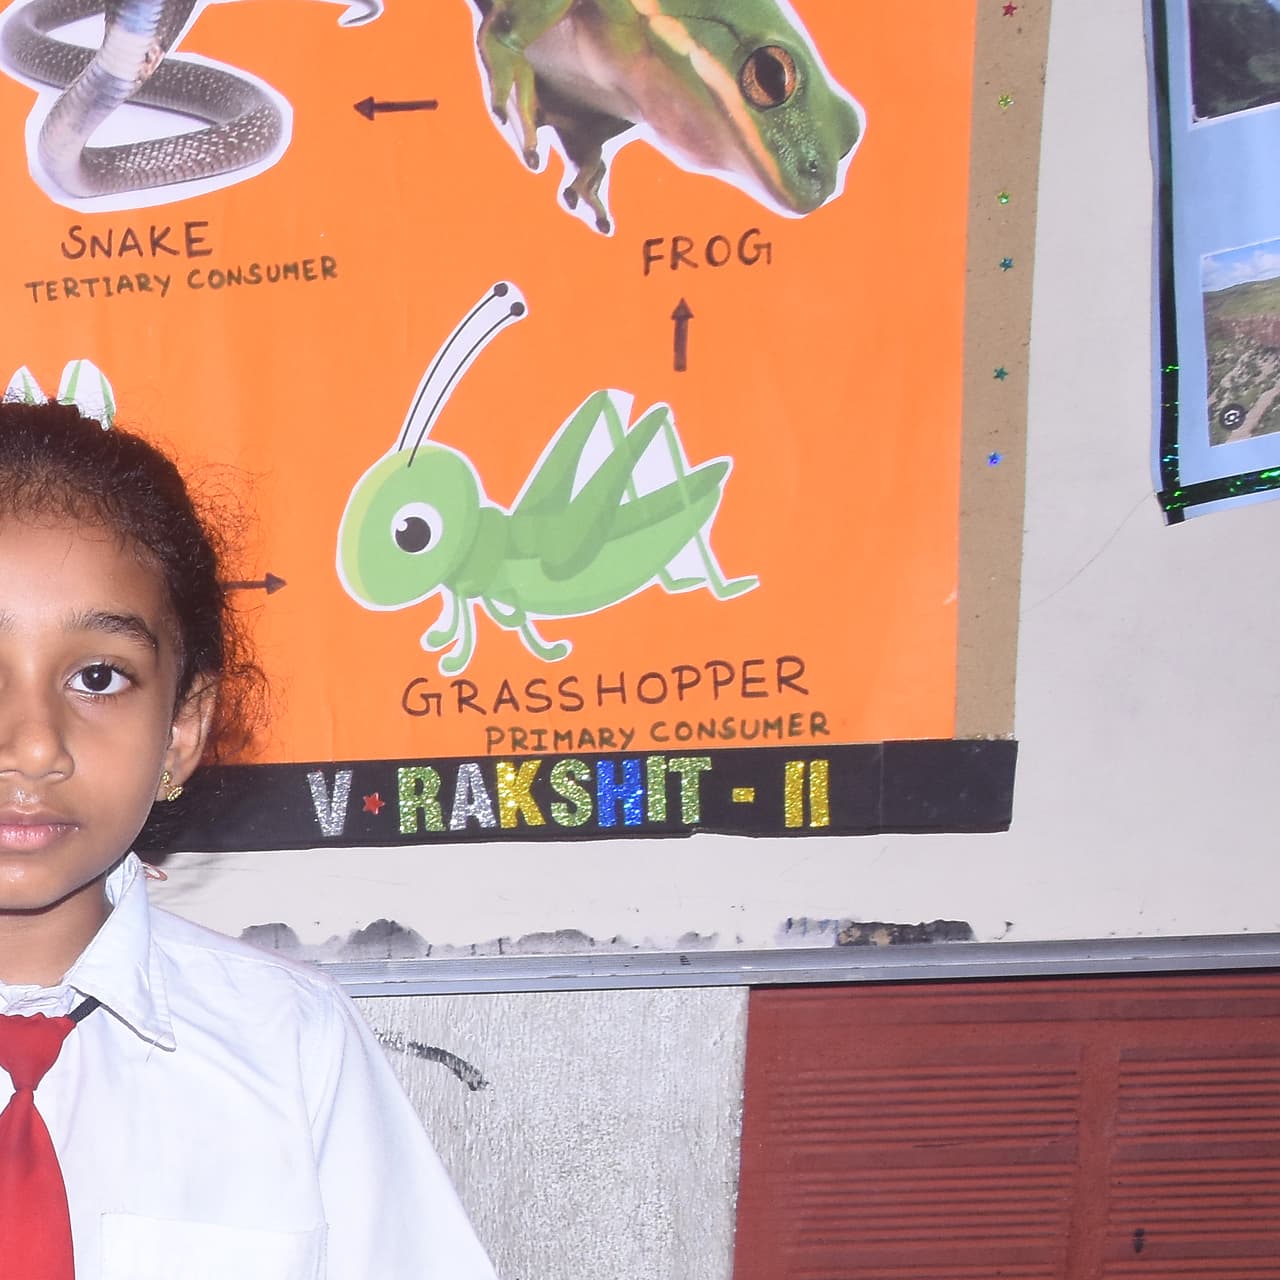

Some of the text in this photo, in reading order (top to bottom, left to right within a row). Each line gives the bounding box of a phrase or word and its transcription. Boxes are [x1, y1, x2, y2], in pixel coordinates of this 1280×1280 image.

[61, 220, 214, 261] SNAKE
[641, 228, 773, 277] FROG
[24, 255, 338, 304] TERTIARY CONSUMER
[401, 654, 810, 720] GRASSHOPPER
[485, 711, 831, 755] PRIMARY CONSUMER
[396, 756, 712, 835] RAKSHIT
[782, 759, 831, 829] II
